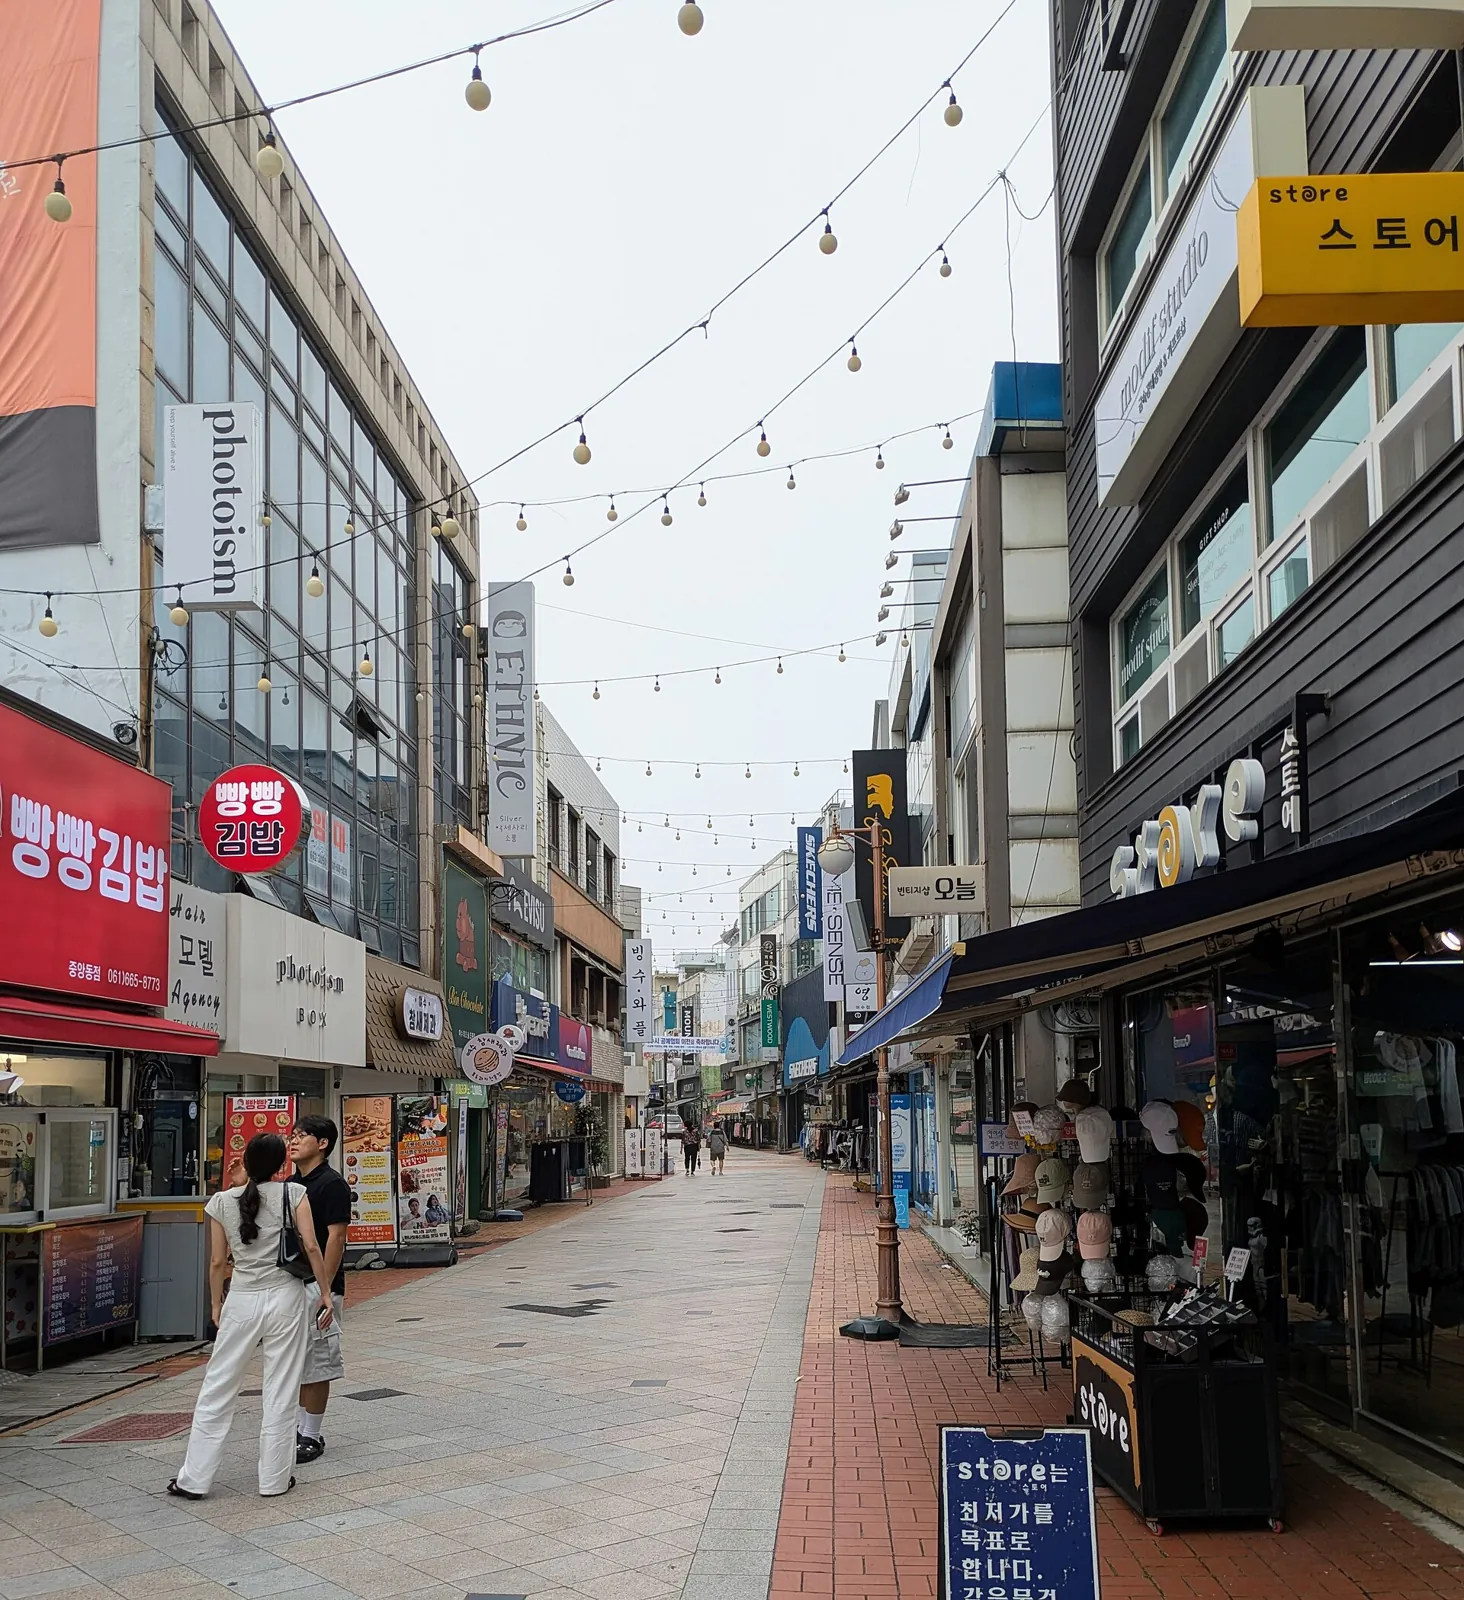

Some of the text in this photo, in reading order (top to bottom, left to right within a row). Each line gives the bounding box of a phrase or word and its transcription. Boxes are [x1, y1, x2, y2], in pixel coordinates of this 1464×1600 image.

[1318, 215, 1459, 252] 스토어
[1119, 230, 1209, 420] modif studio
[169, 408, 177, 424] keep
[169, 424, 177, 450] yourself
[169, 451, 177, 464] alive
[202, 408, 248, 597] photoism
[1199, 507, 1229, 550] GIFT SHOP
[1121, 637, 1145, 686] modif
[495, 649, 527, 799] ETHNIC
[215, 780, 285, 818] 빵빵
[1280, 727, 1301, 834] 스토어
[312, 809, 347, 856] 임대
[499, 815, 523, 823] Silver
[10, 793, 168, 913] 빵빵김밥
[215, 820, 286, 857] 김밥
[805, 832, 817, 933] SKECHERS
[896, 877, 976, 901] 빈티지샵 오늘
[170, 893, 206, 925] Hair
[523, 889, 545, 934] EVISU
[178, 934, 214, 978] 모델
[276, 954, 345, 993] photoism
[69, 961, 161, 992] 중앙동점 061)665-8773
[171, 978, 220, 1018] Agency
[461, 990, 485, 1015] Chocolate
[296, 1007, 328, 1029] BOX
[695, 1038, 719, 1046] 축하합니다
[245, 1098, 287, 1110] 빵빵김밥
[1022, 1483, 1047, 1493] 스토어
[959, 1502, 1055, 1525] 최저가를
[960, 1530, 1032, 1552] 목표로
[961, 1558, 1043, 1582] 합니다.
